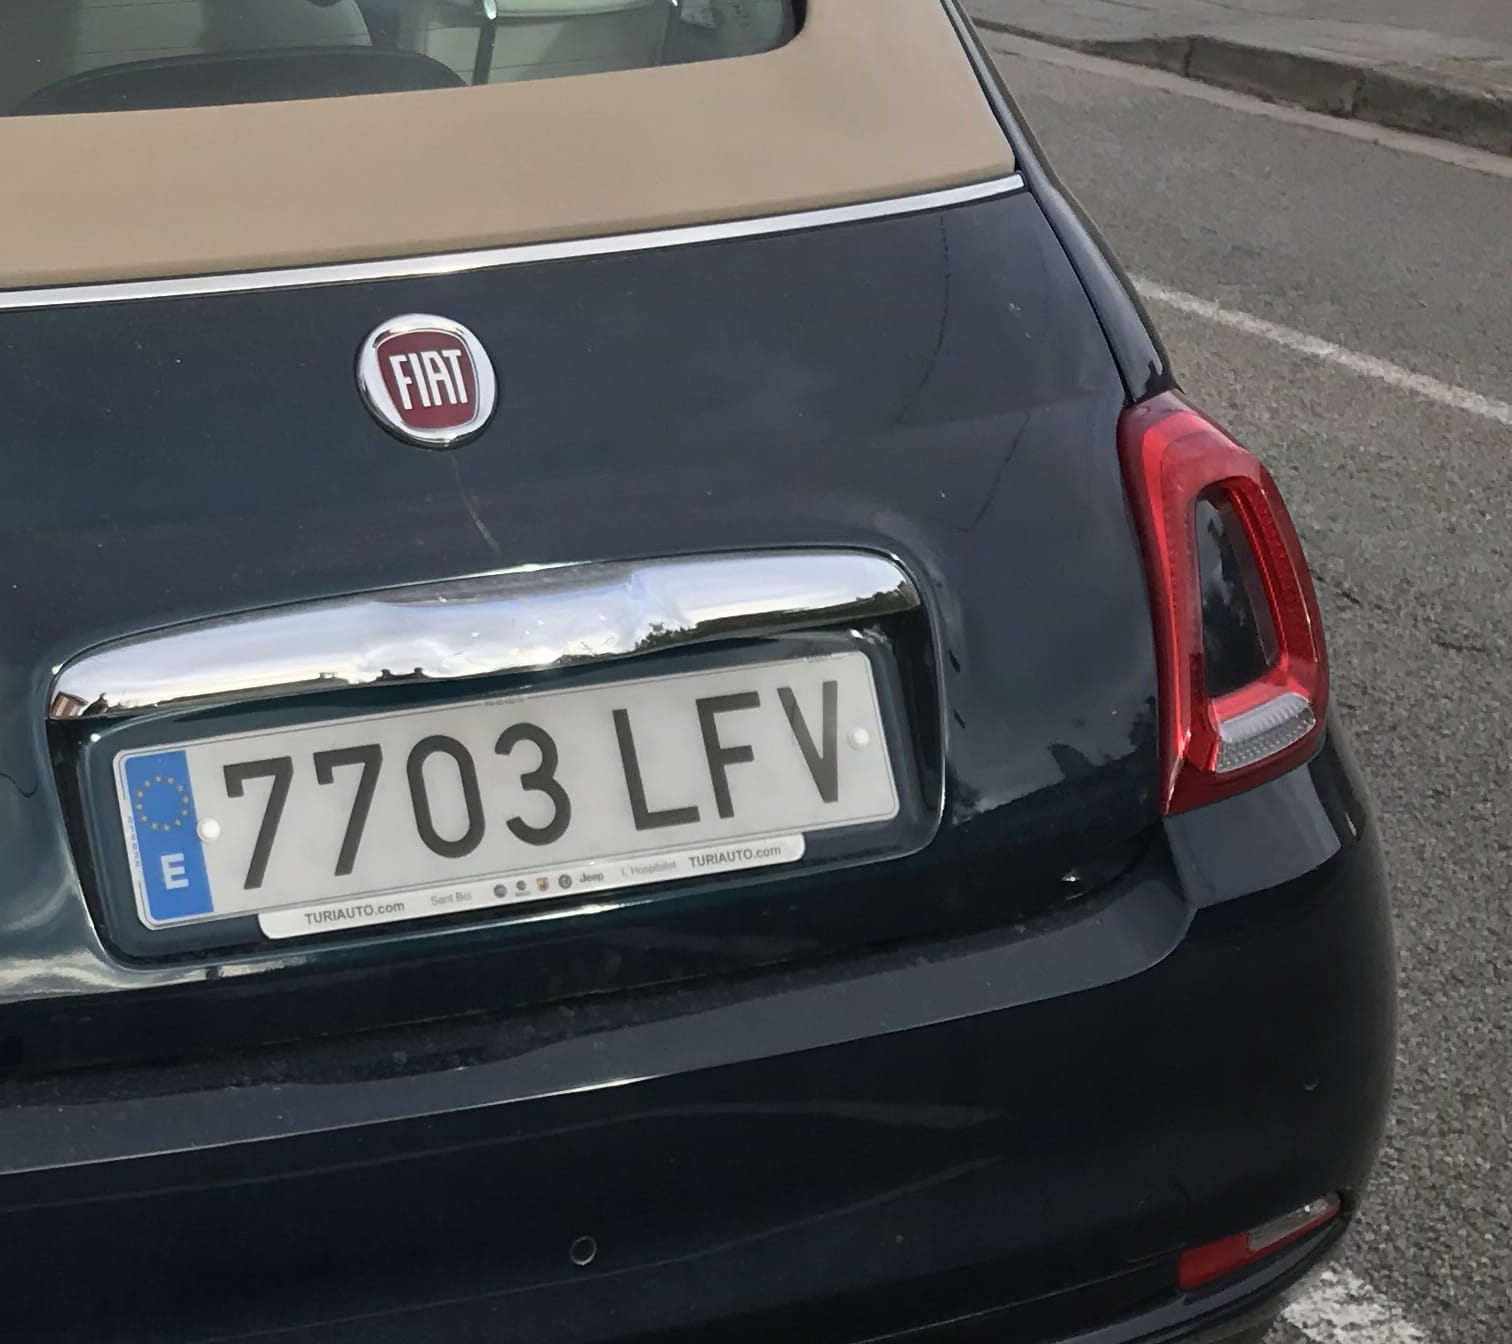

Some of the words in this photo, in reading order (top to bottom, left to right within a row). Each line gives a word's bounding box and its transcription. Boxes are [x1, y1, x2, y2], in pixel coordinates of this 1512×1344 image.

[389, 349, 468, 410] FIAT
[223, 722, 572, 890] 7703
[612, 679, 839, 831] LFV
[160, 852, 190, 891] E
[303, 901, 405, 925] TURIAUTO.com
[579, 871, 605, 884] Jeep
[688, 846, 782, 868] TURIAUTO.com
